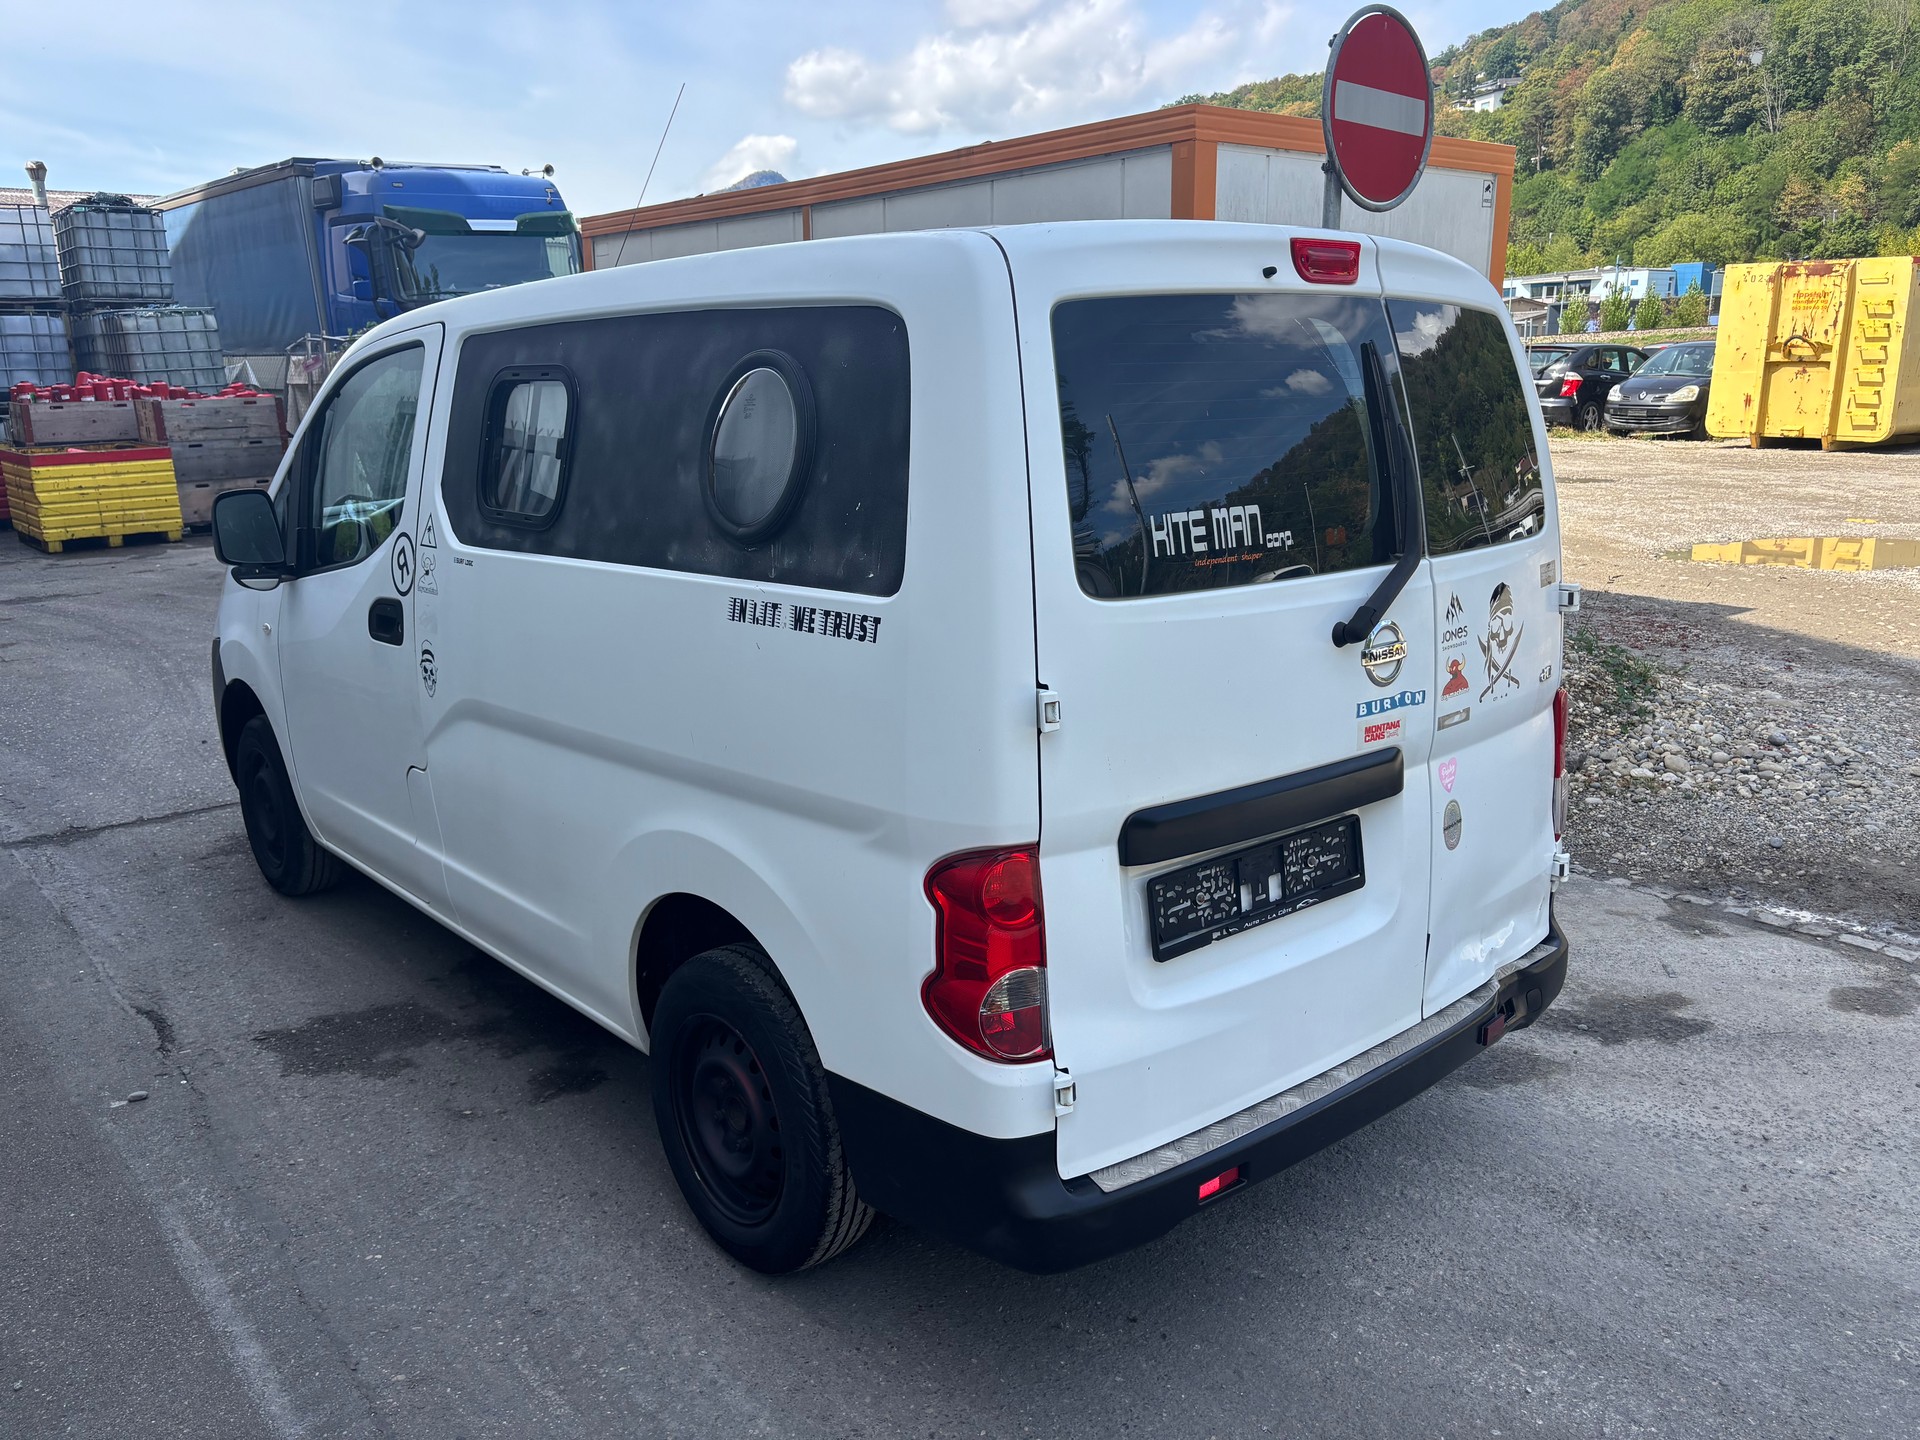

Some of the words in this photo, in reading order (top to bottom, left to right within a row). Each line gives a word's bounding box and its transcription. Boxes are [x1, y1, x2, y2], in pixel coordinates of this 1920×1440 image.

[1150, 510, 1208, 558] KITE
[1211, 504, 1263, 550] MAN
[1194, 554, 1238, 568] independent
[1241, 551, 1264, 565] shaper
[788, 604, 817, 634] WE
[817, 608, 882, 644] TRUST
[1369, 645, 1406, 663] NISSAN
[1360, 691, 1424, 717] BURTON
[1364, 720, 1401, 735] MONTANA
[1364, 731, 1386, 743] CANS
